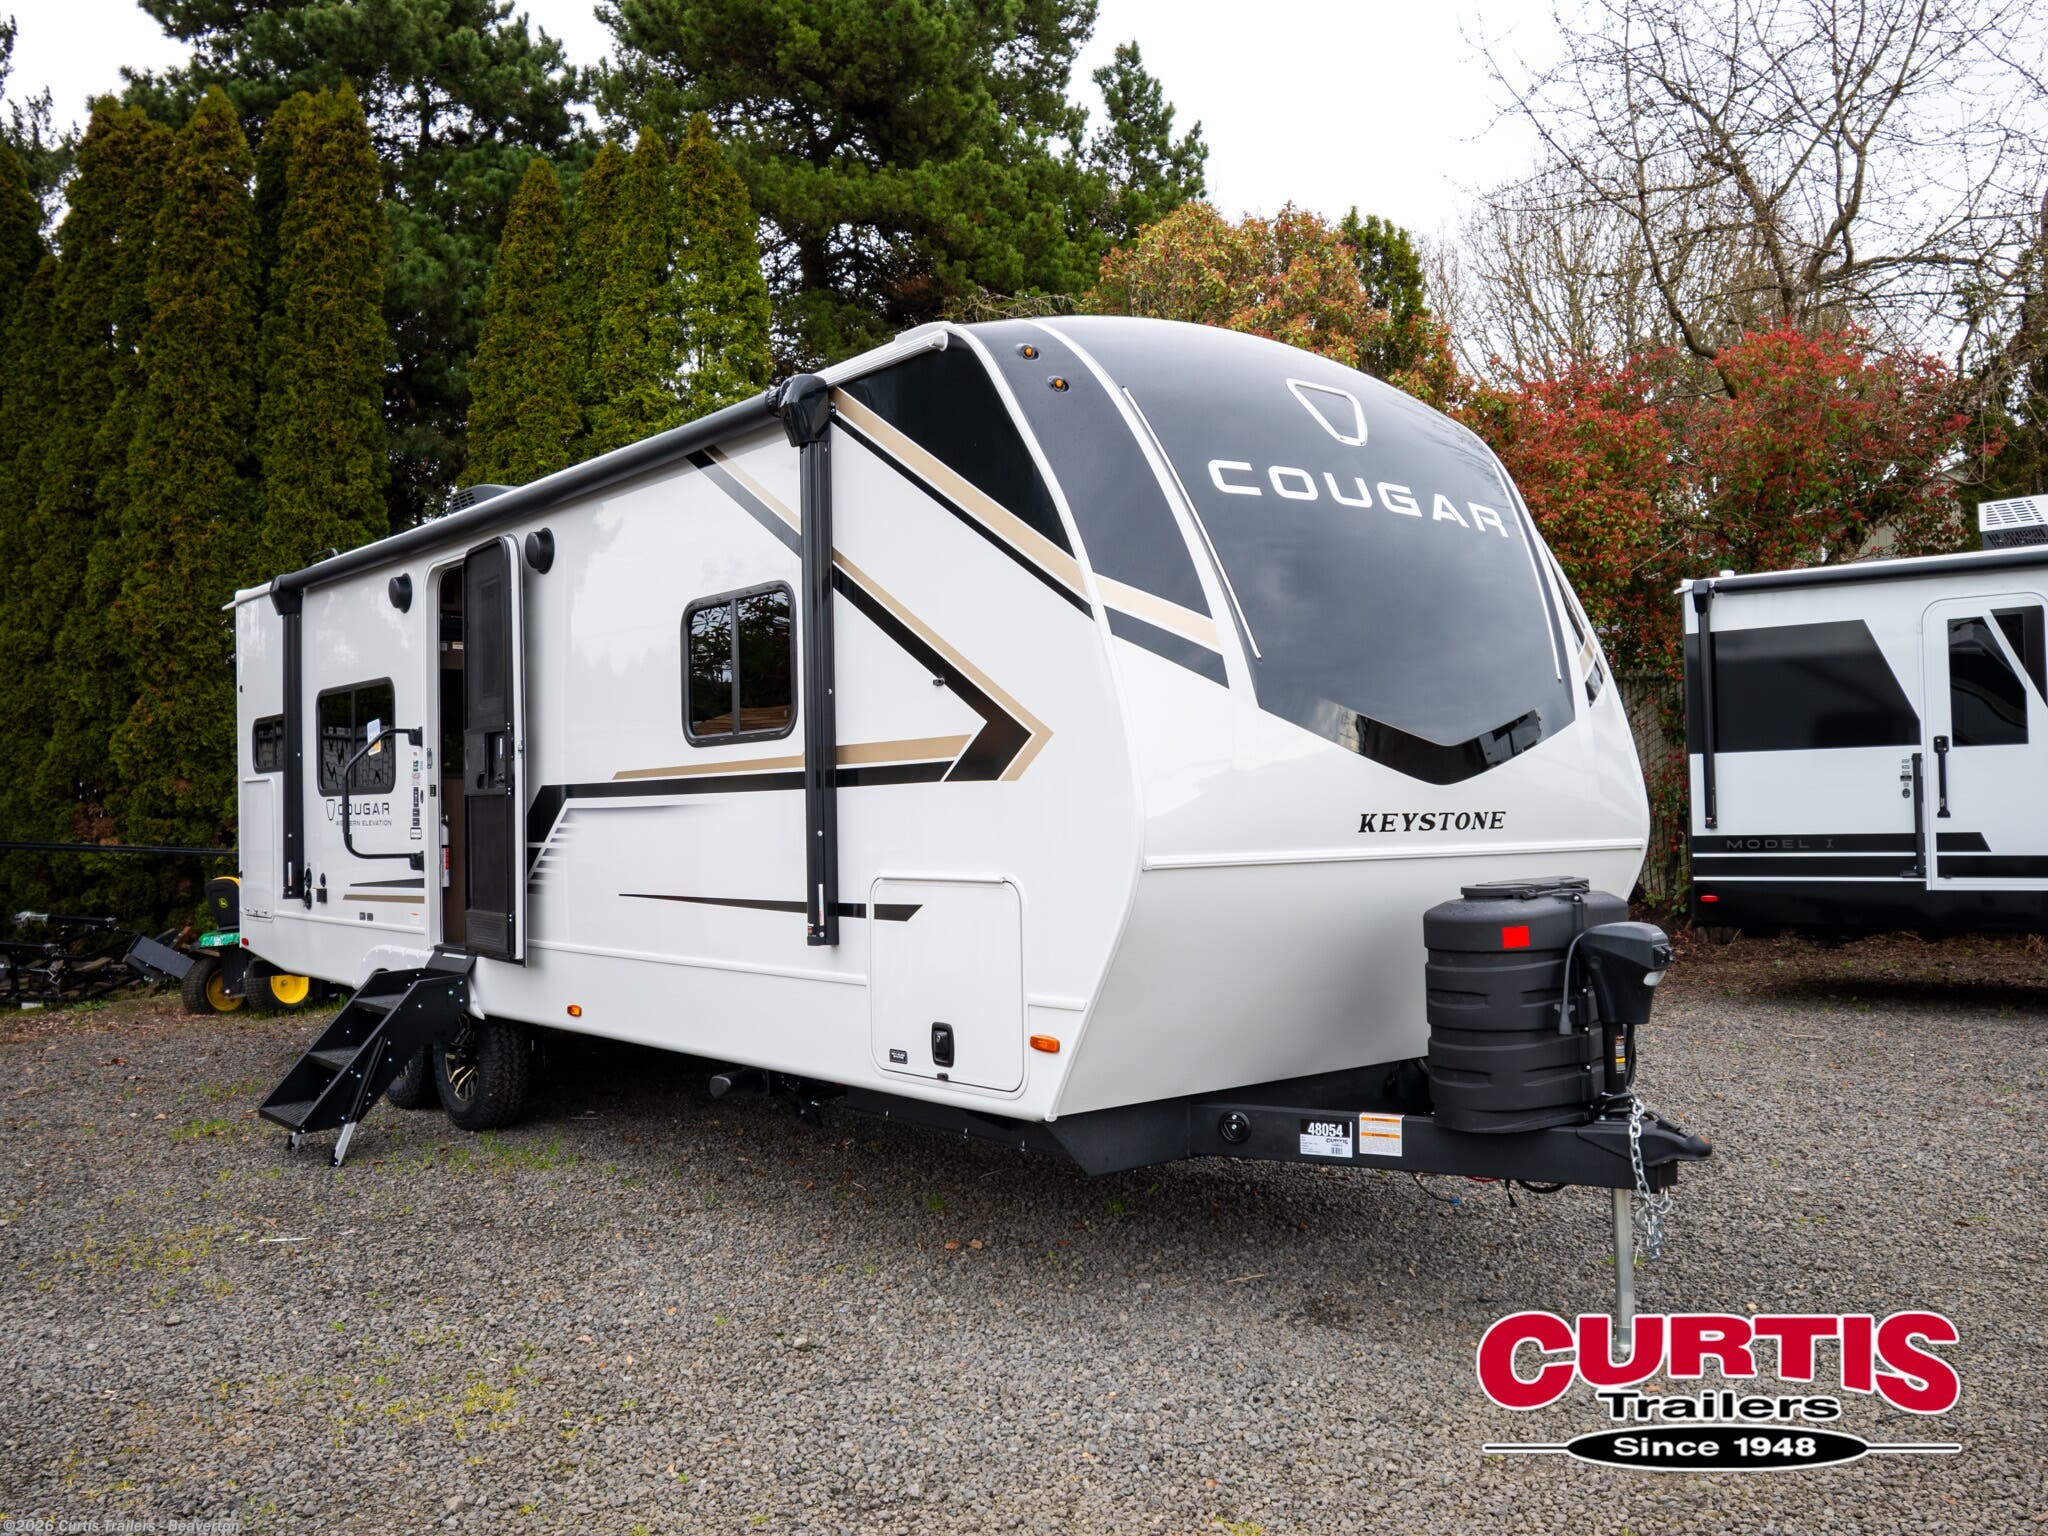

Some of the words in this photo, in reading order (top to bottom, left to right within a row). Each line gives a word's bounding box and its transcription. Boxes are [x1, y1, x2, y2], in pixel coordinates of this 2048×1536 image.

[1207, 458, 1510, 539] COUGAR
[1357, 810, 1507, 834] KEYSTONE
[1725, 838, 1811, 850] MODEL
[1307, 1121, 1344, 1138] 48054
